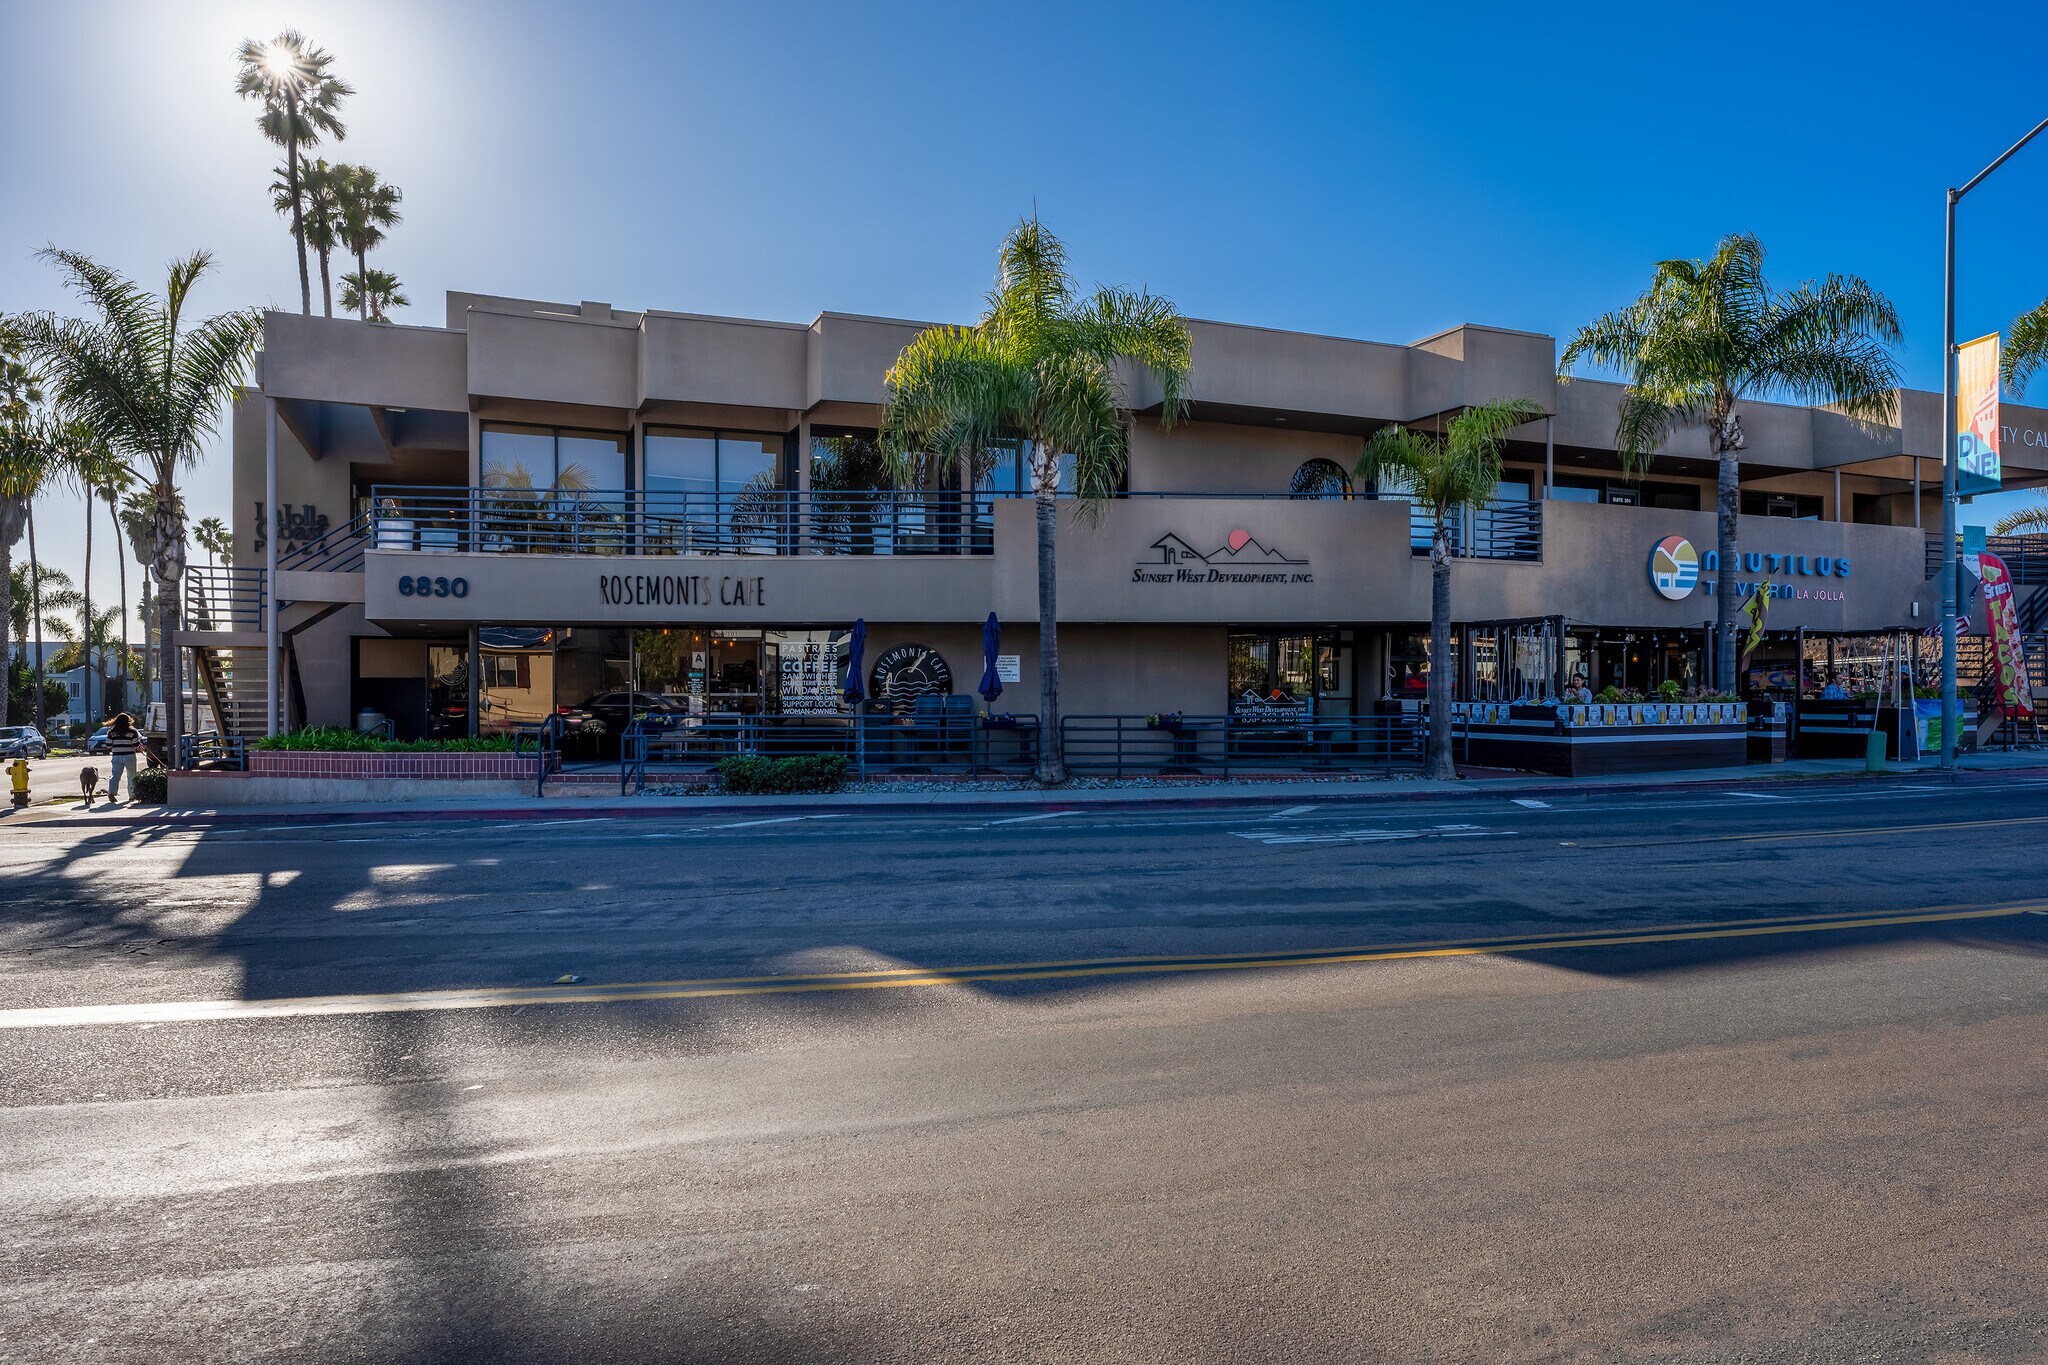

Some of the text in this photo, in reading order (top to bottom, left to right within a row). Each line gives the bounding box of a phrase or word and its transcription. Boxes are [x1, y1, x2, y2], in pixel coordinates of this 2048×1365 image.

[1999, 426, 2018, 443] TY
[254, 540, 329, 555] PAZA
[398, 575, 469, 598] 6830
[600, 575, 765, 606] ROSEMONTS CAFE
[1796, 589, 1809, 599] LA
[1813, 590, 1845, 601] JOLLA
[782, 644, 838, 653] PASTRIES
[1989, 600, 2019, 706] TACOS
[695, 653, 703, 662] A
[782, 661, 838, 672] COFFEE
[930, 657, 948, 680] CAFE
